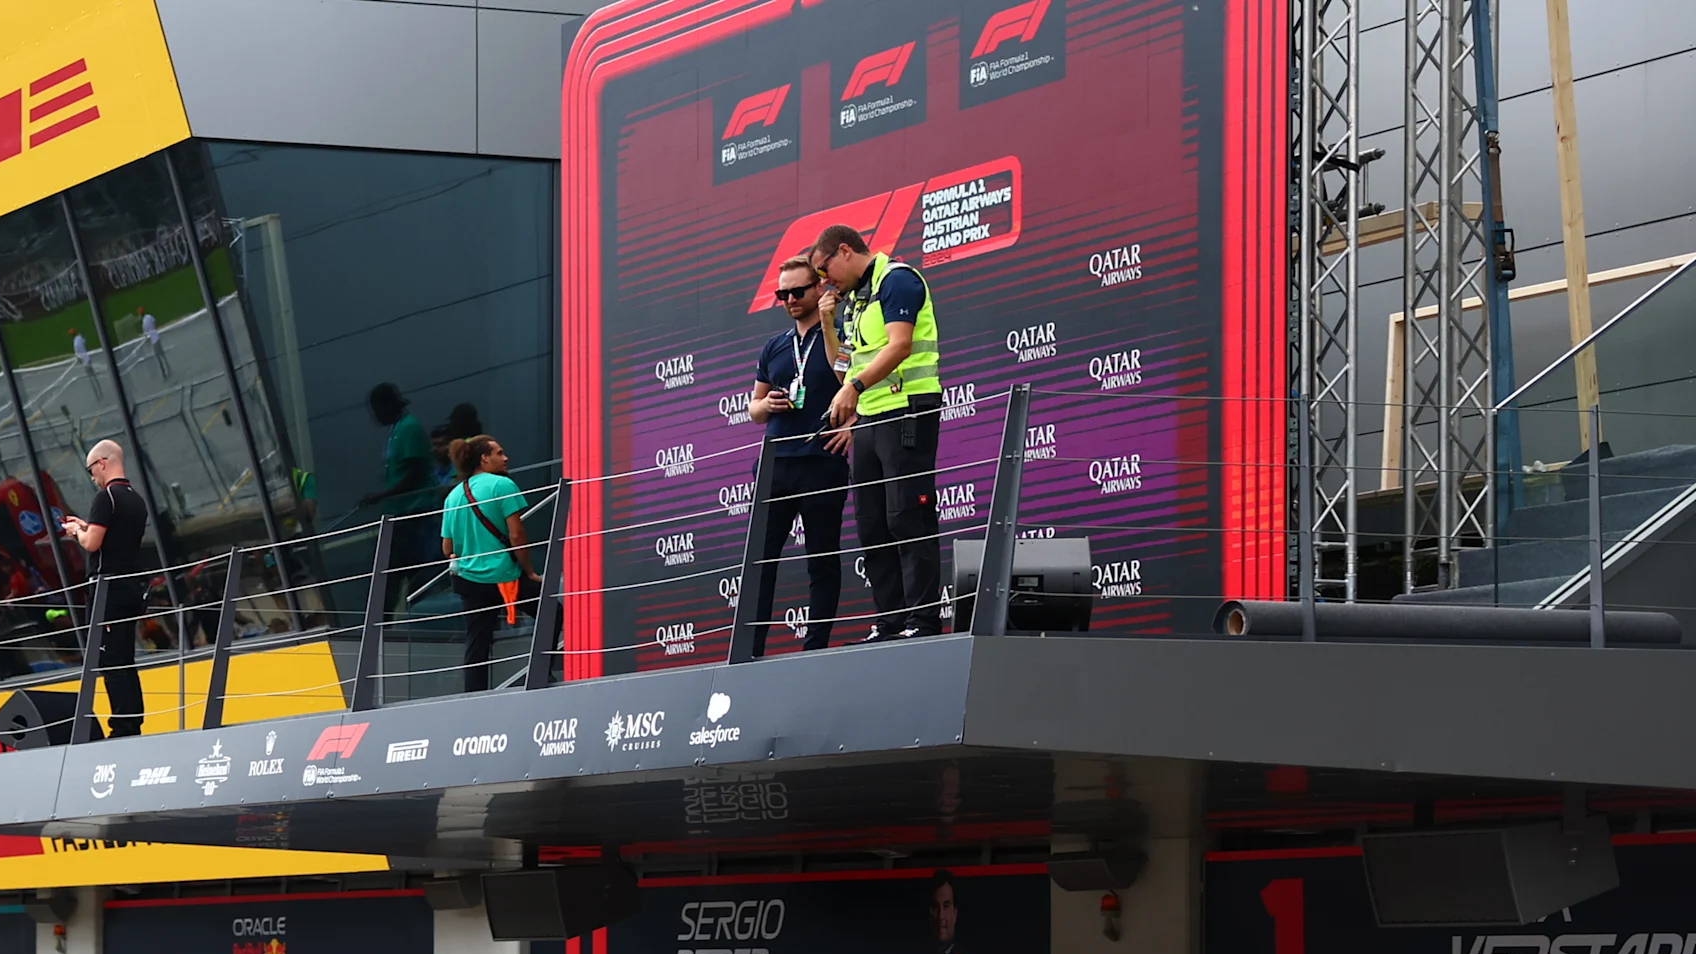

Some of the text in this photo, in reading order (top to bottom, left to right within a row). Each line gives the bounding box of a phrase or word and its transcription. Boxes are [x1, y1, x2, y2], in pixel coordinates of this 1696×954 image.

[922, 179, 986, 209] FORMULA 1
[922, 186, 1012, 224] QATAR AIRWAYS
[922, 211, 980, 239] AUSTRIAN
[922, 223, 991, 255] GRAND PRIX
[1089, 243, 1141, 277] QATAR
[1101, 266, 1142, 288] AIRWAYS
[1006, 322, 1056, 355] QATAR
[1018, 343, 1057, 363] AIRWAYS
[655, 354, 694, 381] QATAR
[1089, 349, 1141, 382] QATAR
[664, 371, 695, 390] AIRWAYS
[1101, 370, 1142, 391] AIRWAYS
[719, 390, 754, 417] QATA
[941, 383, 975, 408] ATAR
[939, 403, 976, 422] AIRWAYS
[656, 443, 694, 471] QATAR
[665, 460, 695, 478] AIRWAYS
[1089, 454, 1141, 486] QATAR
[1101, 474, 1142, 495] AIRWAYS
[939, 503, 976, 522] AIRWAYS
[656, 533, 694, 560] QATAR
[665, 548, 695, 567] AIRWAYS
[1101, 575, 1142, 598] AIRWAYS
[656, 622, 694, 648] QATAR
[665, 638, 695, 656] AIRWAYS
[533, 718, 578, 747] QATAR
[624, 711, 665, 739] MSC
[689, 724, 741, 748] salesforce
[386, 739, 430, 764] PIRELLI
[453, 733, 508, 756] aramco
[539, 741, 576, 757] AIRWAYS
[622, 740, 662, 752] CRUISES
[93, 764, 117, 784] aws
[138, 766, 172, 787] DHL
[196, 763, 231, 778] Heineken
[248, 758, 285, 777] ROLEX
[232, 916, 287, 937] ORACLE
[677, 899, 786, 941] SERGIO
